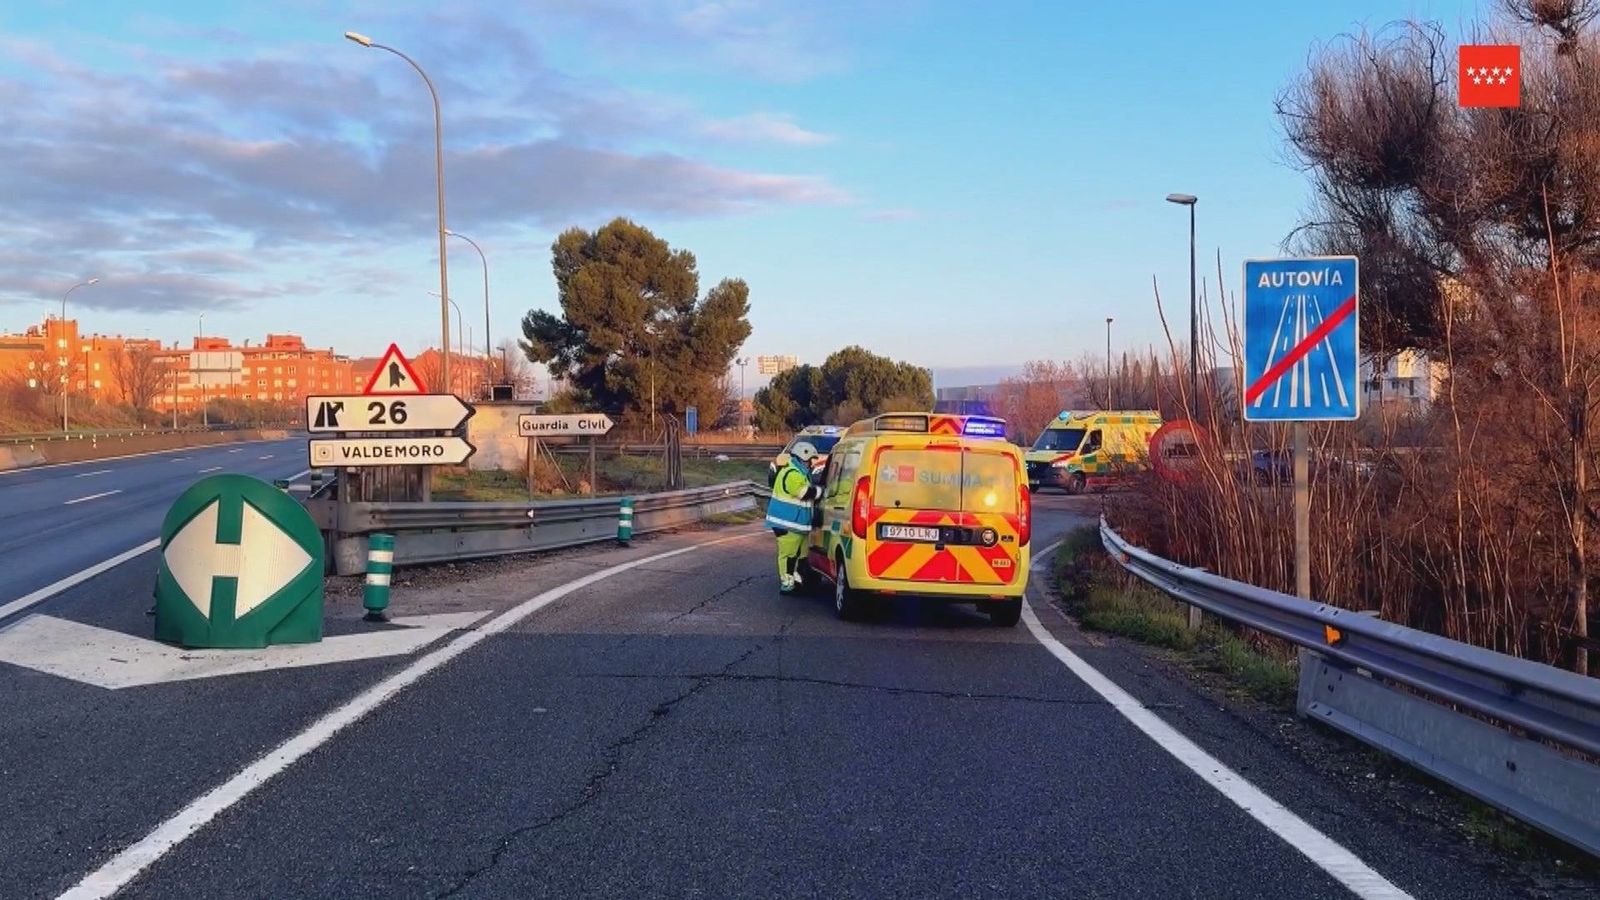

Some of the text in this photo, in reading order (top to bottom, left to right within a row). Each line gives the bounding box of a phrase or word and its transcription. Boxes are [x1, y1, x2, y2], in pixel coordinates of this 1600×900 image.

[1258, 267, 1343, 288] AUTOVÍA
[367, 401, 408, 425] 26
[522, 420, 606, 430] Guardia Civil
[341, 445, 444, 458] VALDEMORO
[889, 526, 915, 538] 9710
